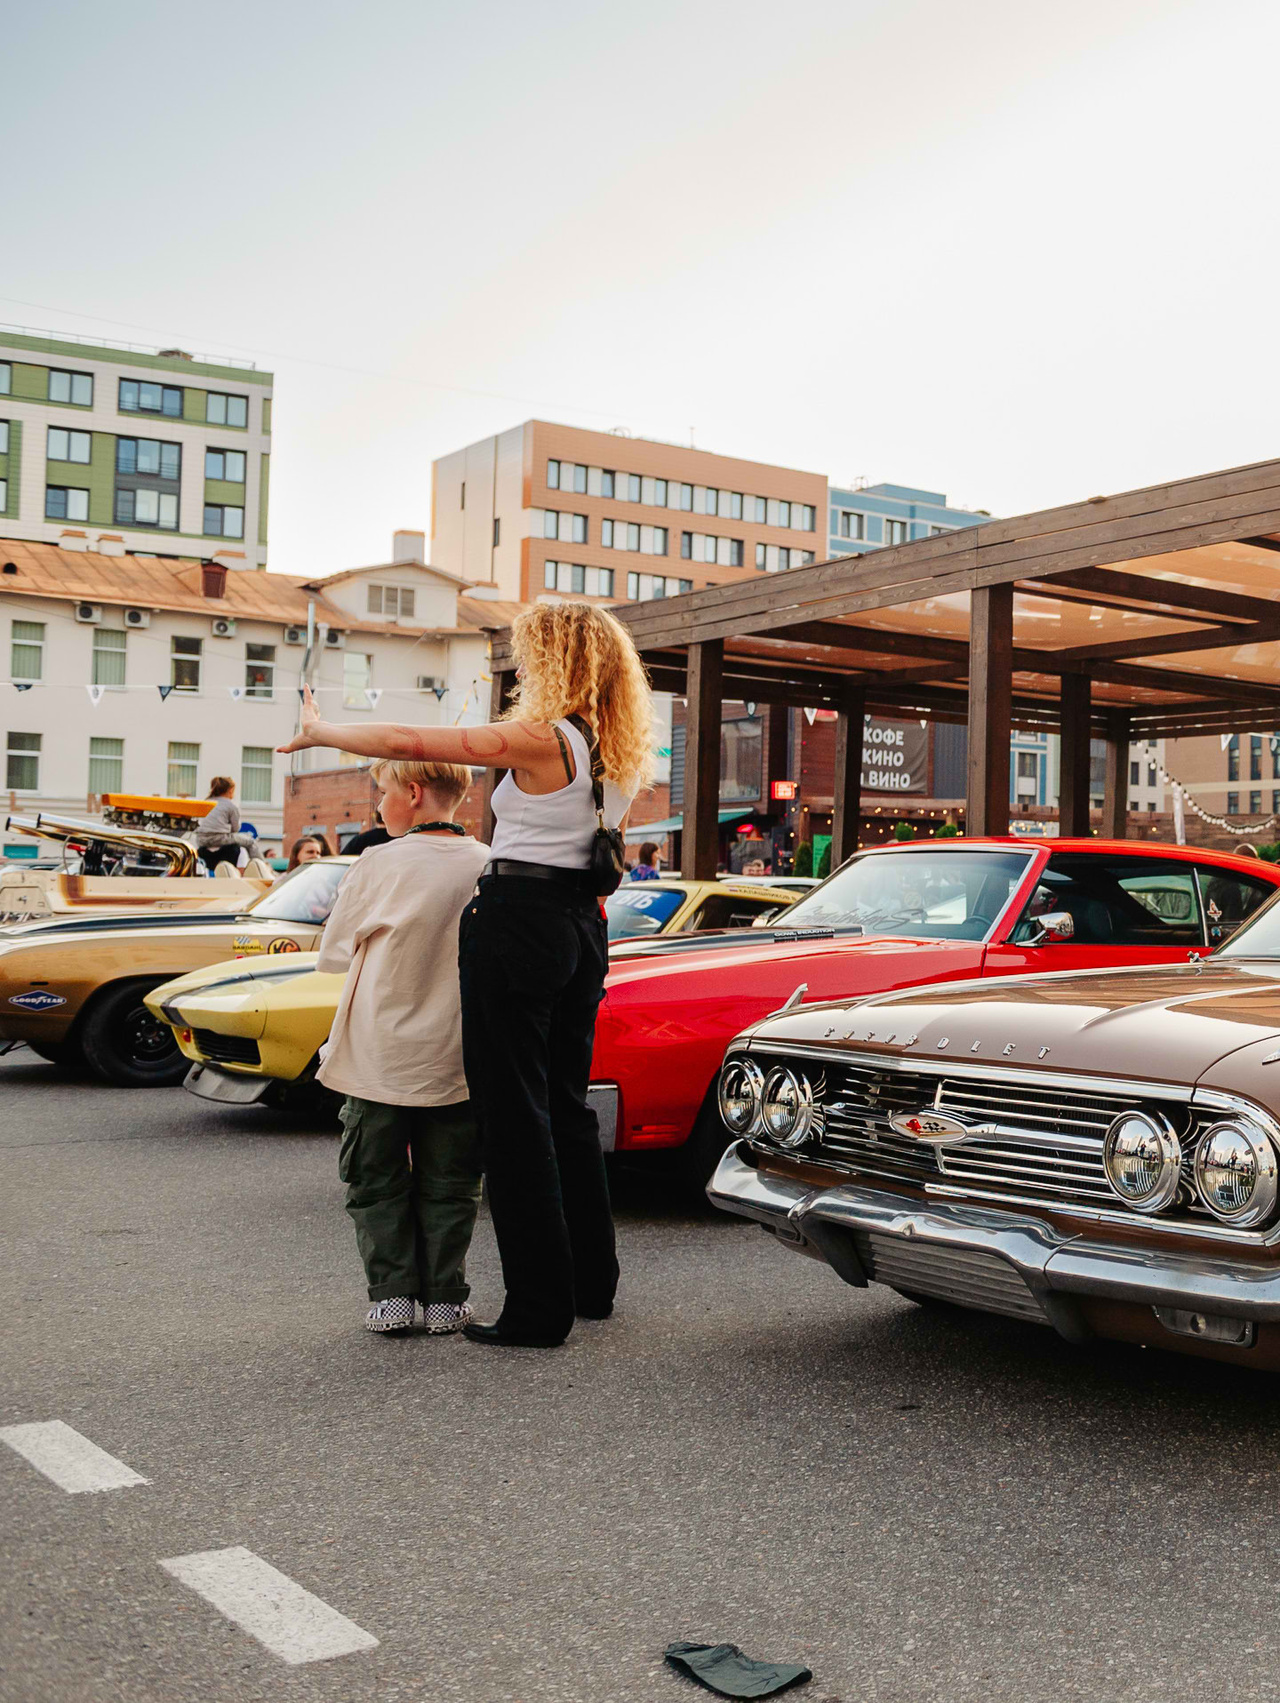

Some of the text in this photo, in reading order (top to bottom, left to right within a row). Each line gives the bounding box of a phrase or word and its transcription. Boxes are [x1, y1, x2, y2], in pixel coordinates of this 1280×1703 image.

[863, 726, 905, 746] КОФЕ
[862, 748, 904, 767] КИНО
[868, 770, 911, 788] ВИНО
[615, 891, 662, 909] ВТБ
